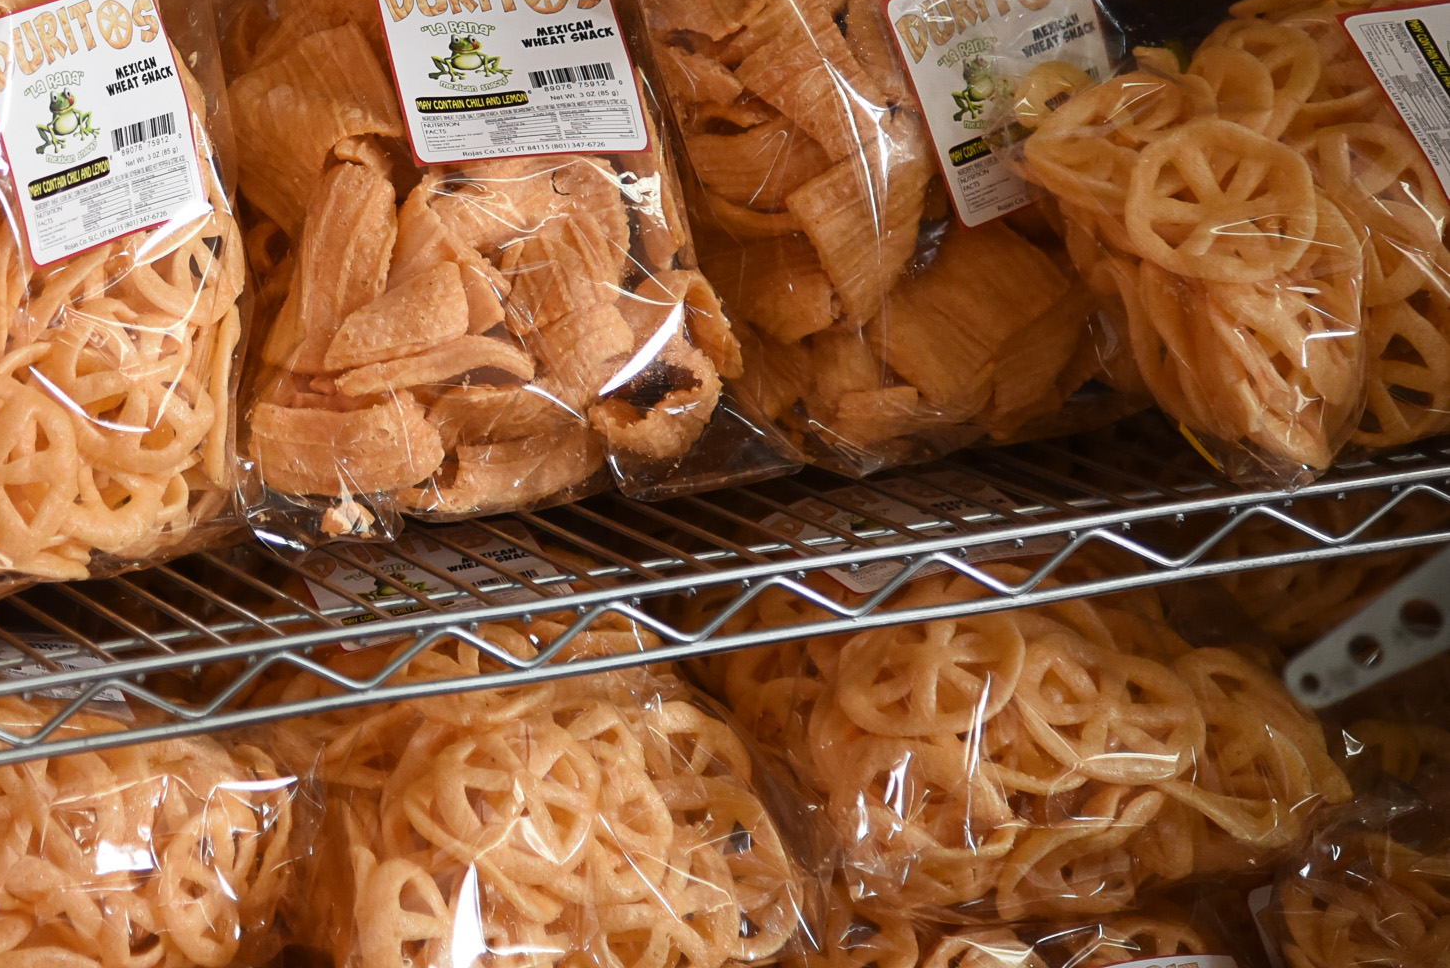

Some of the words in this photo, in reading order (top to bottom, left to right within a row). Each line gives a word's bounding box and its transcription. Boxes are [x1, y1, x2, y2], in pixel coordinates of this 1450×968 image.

[521, 34, 566, 49] WHEAT
[571, 26, 615, 43] SNACK
[536, 19, 594, 37] MEXICAN
[1032, 13, 1080, 42] MEXICAN
[1381, 24, 1395, 43] FACTS
[1388, 22, 1410, 53] NUTRITION
[1021, 35, 1061, 59] WHEAT
[1064, 21, 1096, 44] SNACK
[1416, 33, 1439, 60] CONTAIN
[115, 56, 157, 81] MEXICAN
[106, 79, 139, 97] WHEAT
[142, 65, 174, 86] SNACK
[439, 79, 479, 93] mexican
[544, 83, 572, 93] 89076
[578, 80, 606, 89] 75912
[416, 99, 433, 111] MAY
[433, 98, 464, 110] CONTAIN
[465, 97, 486, 109] CHILI
[486, 96, 501, 107] AND
[502, 93, 528, 105] LEMON
[550, 93, 564, 101] Net
[597, 89, 609, 98] (85
[610, 89, 619, 98] g)
[1366, 51, 1378, 67] Rojas
[1398, 102, 1412, 122] 84115
[1409, 120, 1423, 136] (801)
[1418, 135, 1440, 166] 347-6726
[121, 143, 143, 157] 89076
[147, 135, 169, 149] 75912
[462, 149, 483, 158] Rojas
[498, 146, 514, 154] SLC,
[527, 144, 550, 152] 84115
[551, 142, 570, 151] (801)
[572, 141, 606, 149] 347-6726
[125, 159, 136, 168] Net
[161, 148, 172, 159] (85
[29, 182, 43, 198] MAY
[42, 175, 67, 194] CONTAIN
[66, 170, 81, 186] CHILI
[81, 166, 92, 180] AND
[91, 160, 110, 177] LEMON
[960, 168, 990, 183] NUTRITION
[963, 181, 981, 192] FACTS
[64, 242, 79, 251] Rojas
[79, 238, 88, 246] Co.
[100, 229, 108, 238] UT
[107, 224, 124, 236] 84115
[123, 219, 139, 231] (801)
[139, 210, 169, 225] 347-6726
[446, 559, 485, 573] WHEA
[342, 616, 358, 626] MAY
[392, 606, 412, 617] CHILI
